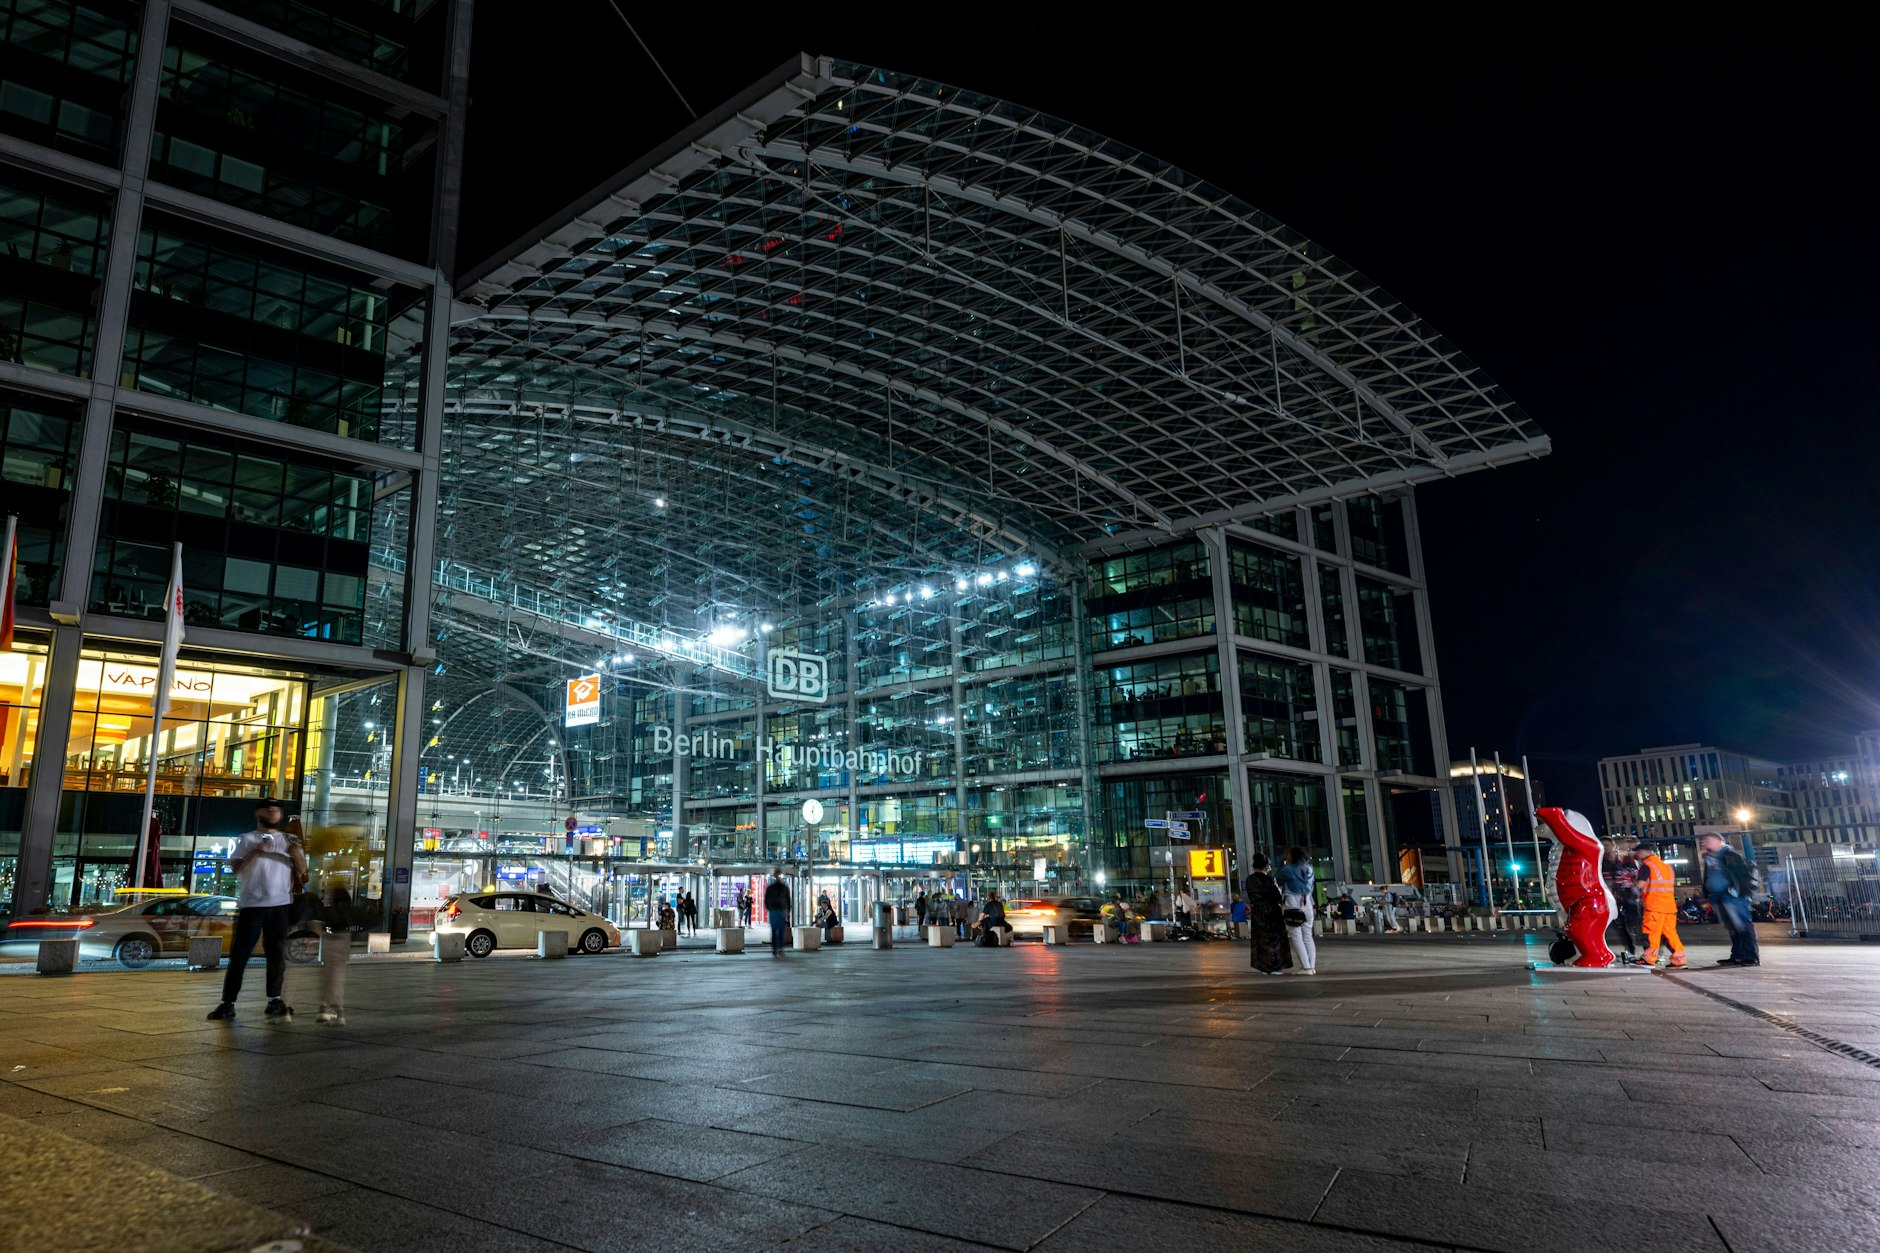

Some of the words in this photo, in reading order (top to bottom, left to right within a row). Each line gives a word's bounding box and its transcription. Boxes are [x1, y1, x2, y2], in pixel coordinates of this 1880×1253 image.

[108, 672, 211, 691] VAPNO
[775, 658, 821, 695] DB
[654, 725, 734, 760] Berlin
[756, 736, 921, 775] Hauptbahnhof
